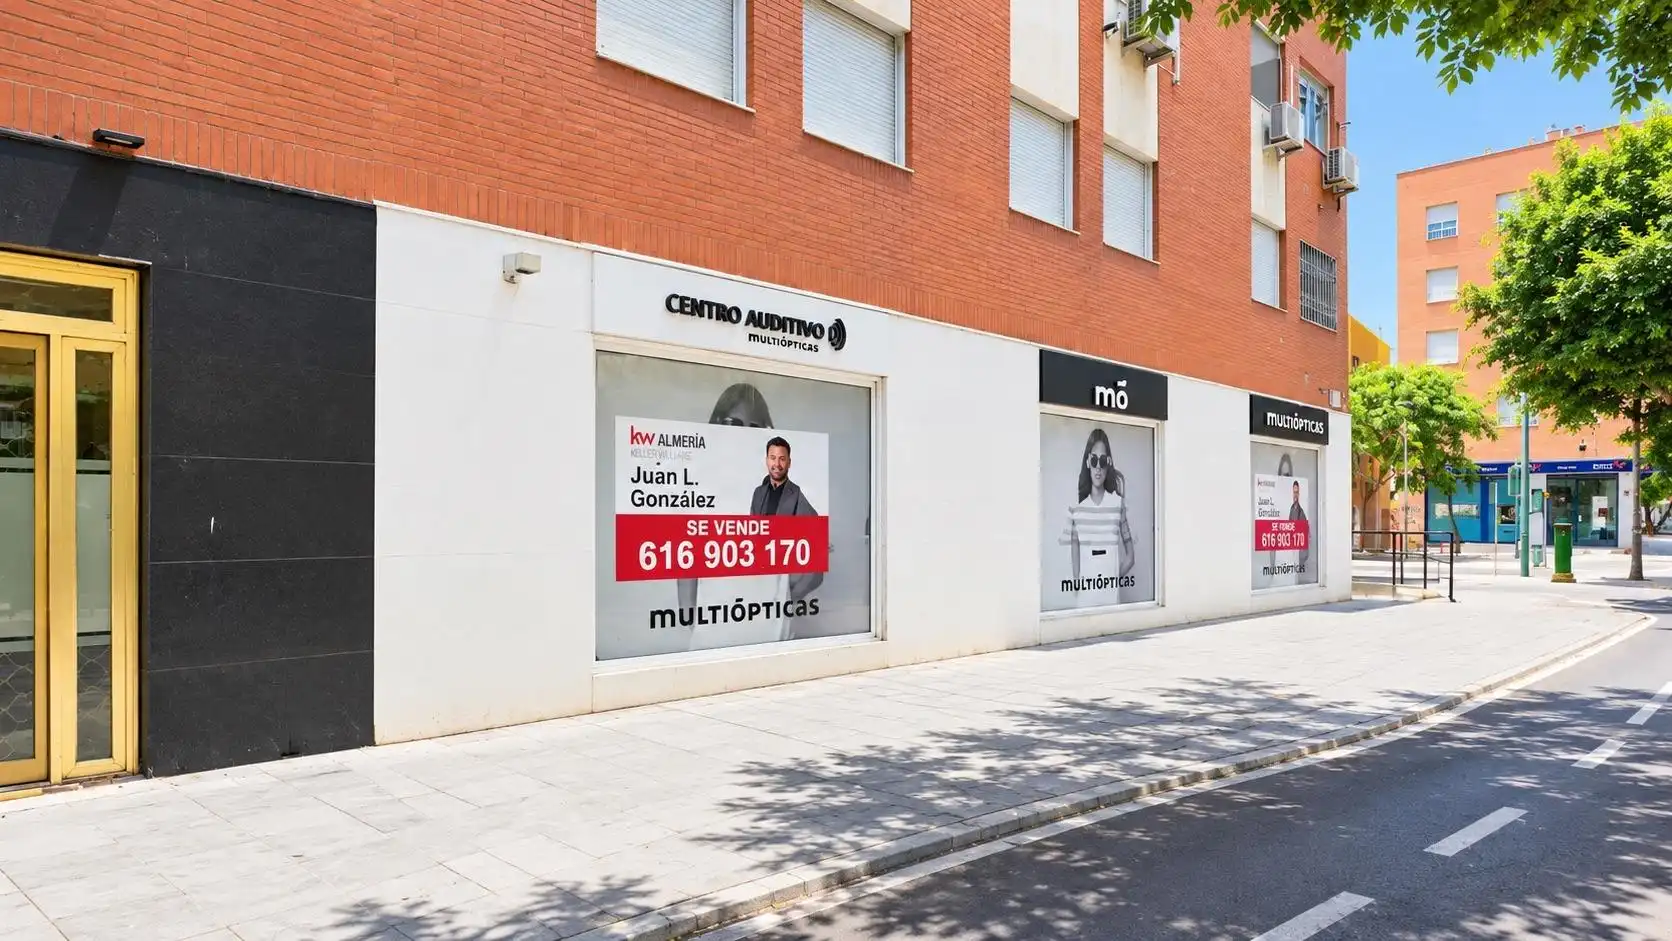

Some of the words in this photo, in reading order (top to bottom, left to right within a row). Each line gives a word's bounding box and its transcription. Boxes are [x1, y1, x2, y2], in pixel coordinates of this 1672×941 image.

[665, 293, 742, 324] CENTRO
[745, 309, 825, 340] AUDITIVO
[630, 425, 655, 446] kw
[657, 433, 706, 449] ALMERÍA
[630, 466, 677, 485] Juan
[683, 468, 699, 486] L.
[630, 489, 715, 508] González
[687, 520, 708, 536] SE
[714, 520, 770, 536] VENDE
[1261, 533, 1276, 548] 616
[1277, 533, 1291, 547] 903
[1293, 532, 1305, 547] 170
[638, 541, 694, 571] 616
[704, 540, 755, 569] 903
[765, 539, 810, 567] 170
